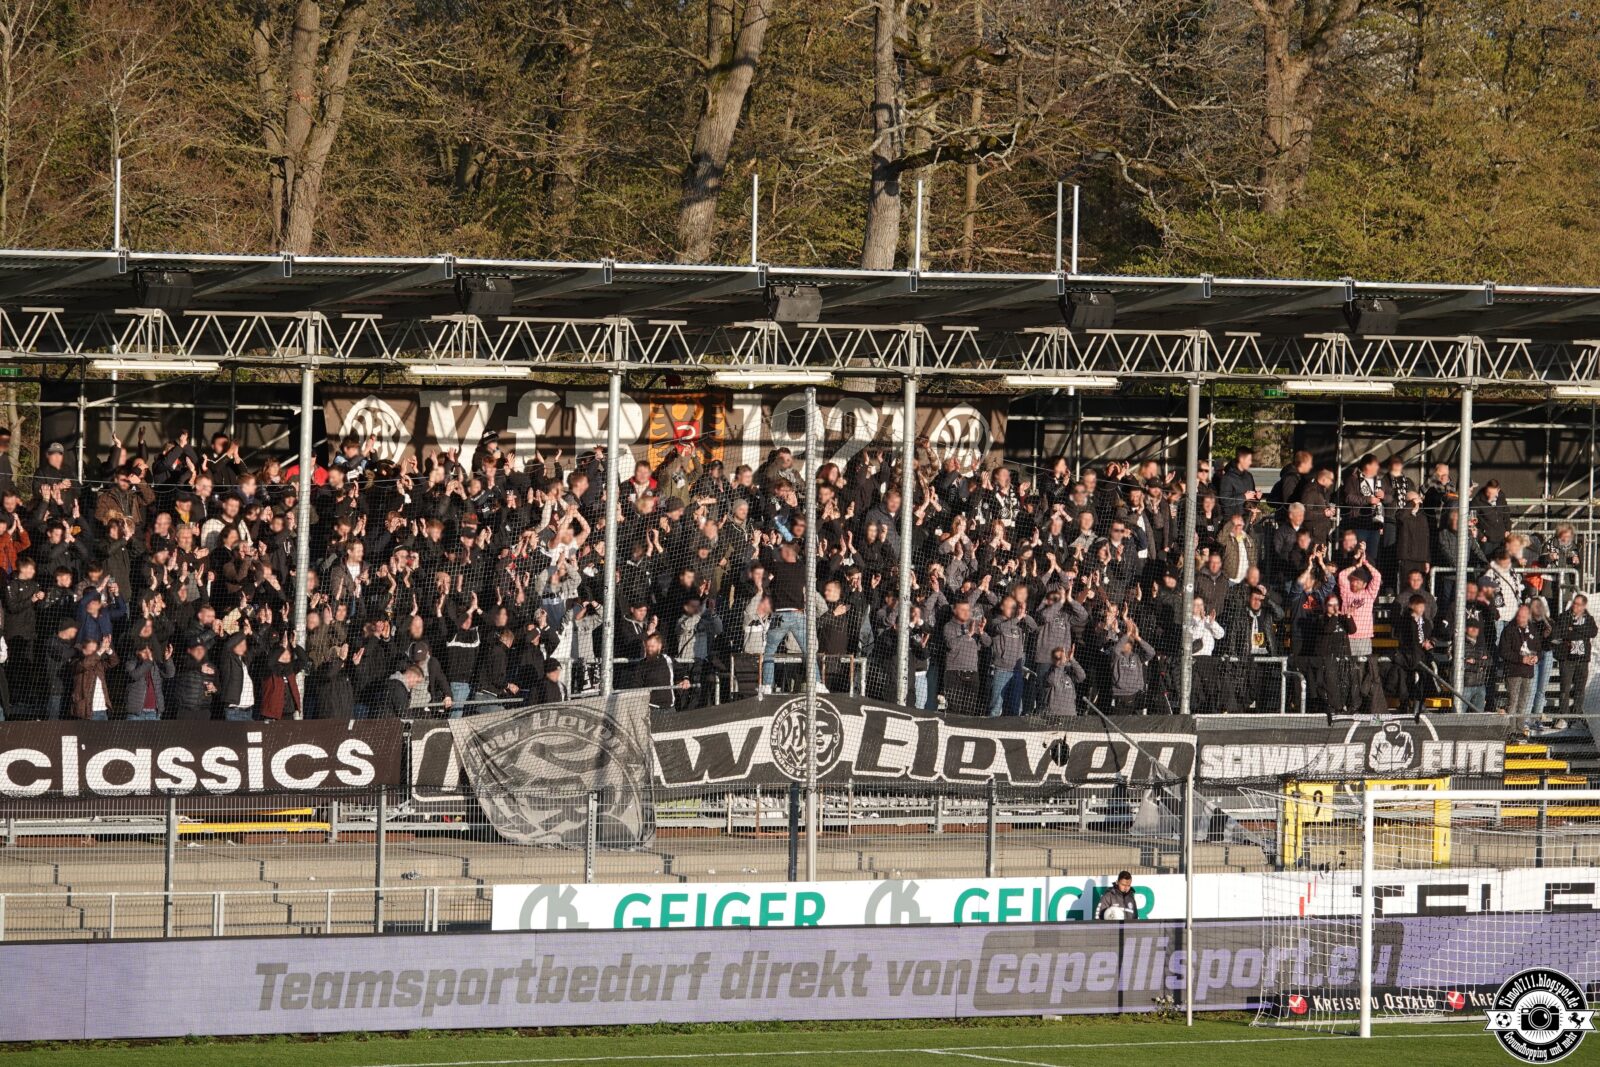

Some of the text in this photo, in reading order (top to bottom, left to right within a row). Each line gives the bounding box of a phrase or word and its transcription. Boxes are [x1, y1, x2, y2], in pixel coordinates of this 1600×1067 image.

[0, 731, 376, 797] classics
[853, 706, 1197, 786] Eleven
[1201, 740, 1505, 779] SCHWARZE ELITE
[613, 892, 825, 928] GEIGER
[255, 936, 1393, 1017] Teamsportbedarf direkt von capellisport.eu
[1313, 993, 1435, 1012] KREISBU OSTALB
